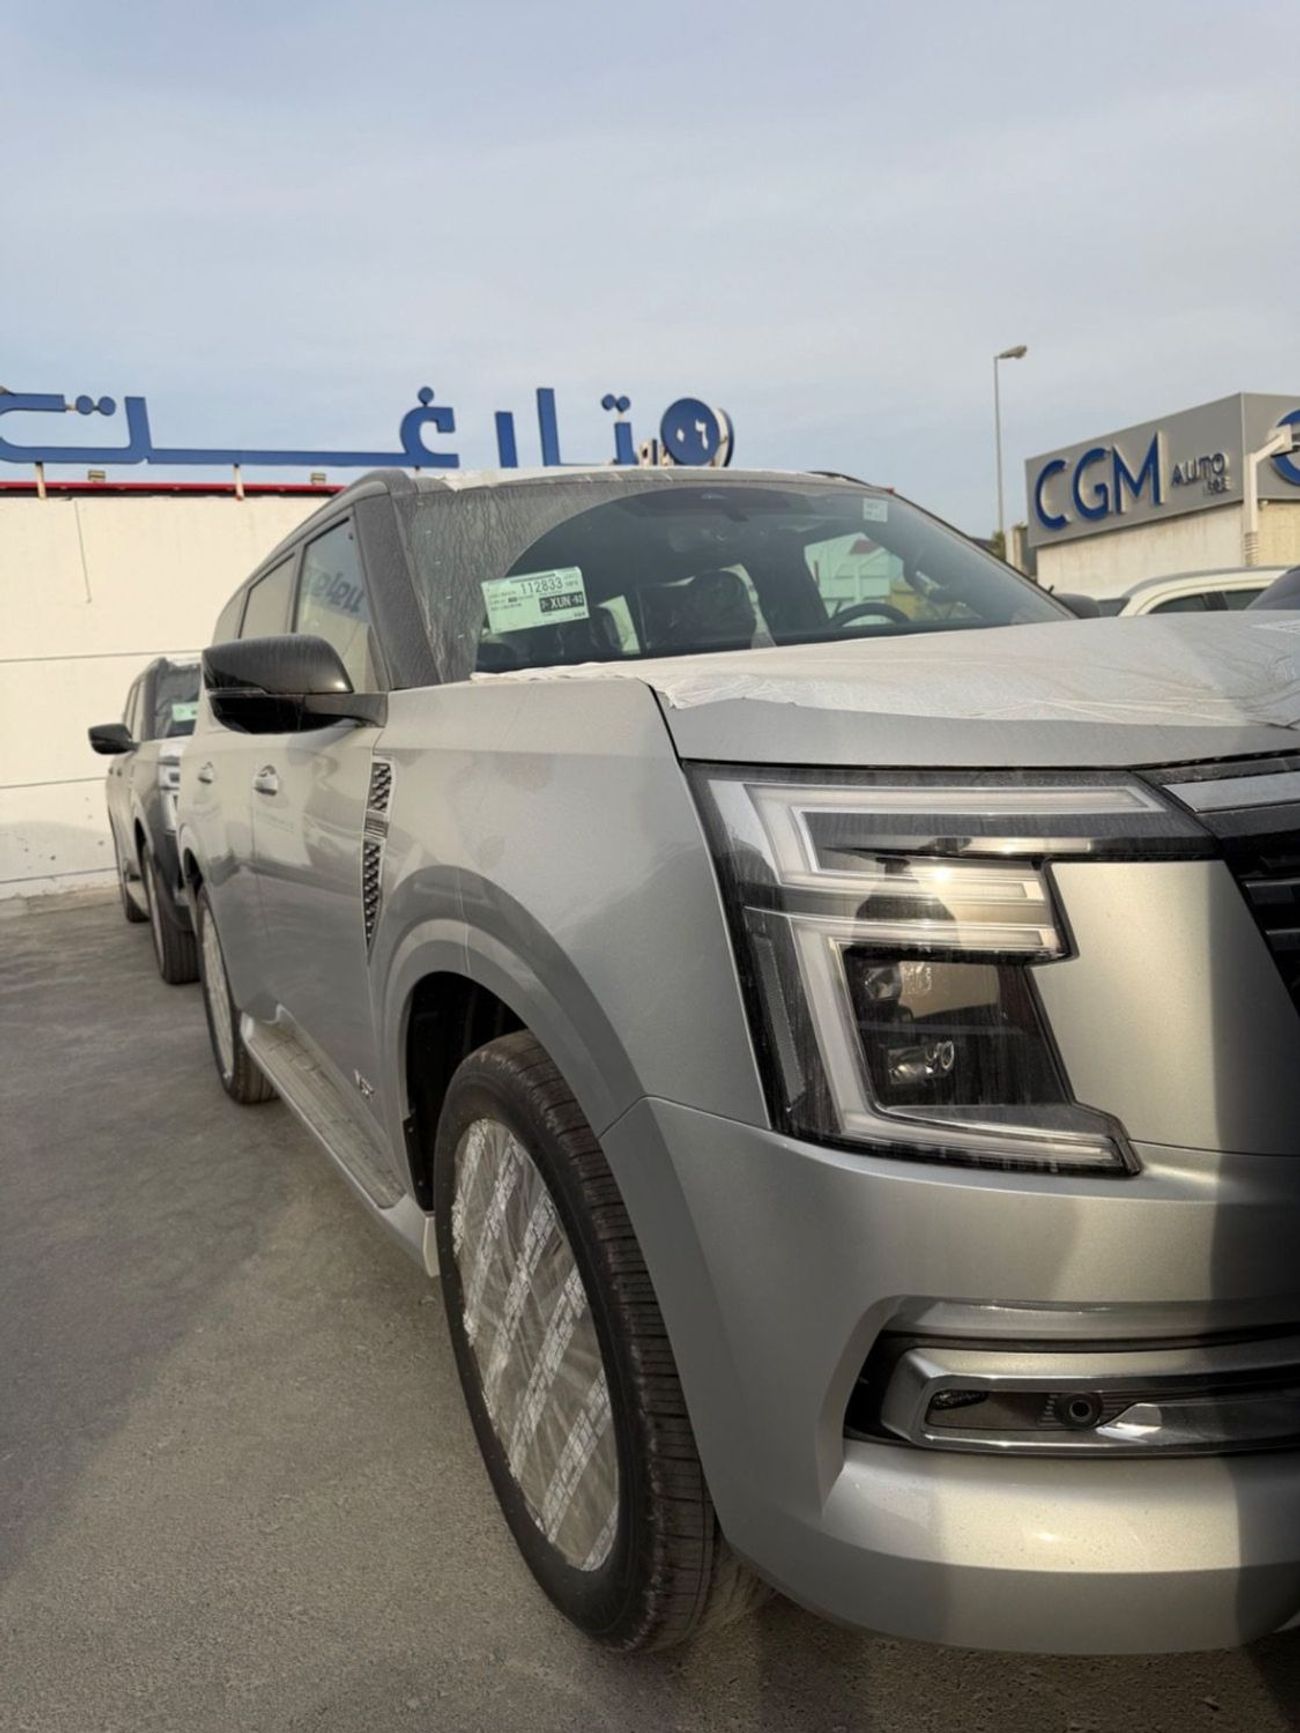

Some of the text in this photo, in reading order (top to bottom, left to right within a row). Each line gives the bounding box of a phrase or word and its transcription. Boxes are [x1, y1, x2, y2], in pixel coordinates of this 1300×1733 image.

[1035, 432, 1229, 530] CGM AUTO
[520, 576, 563, 595] 112833
